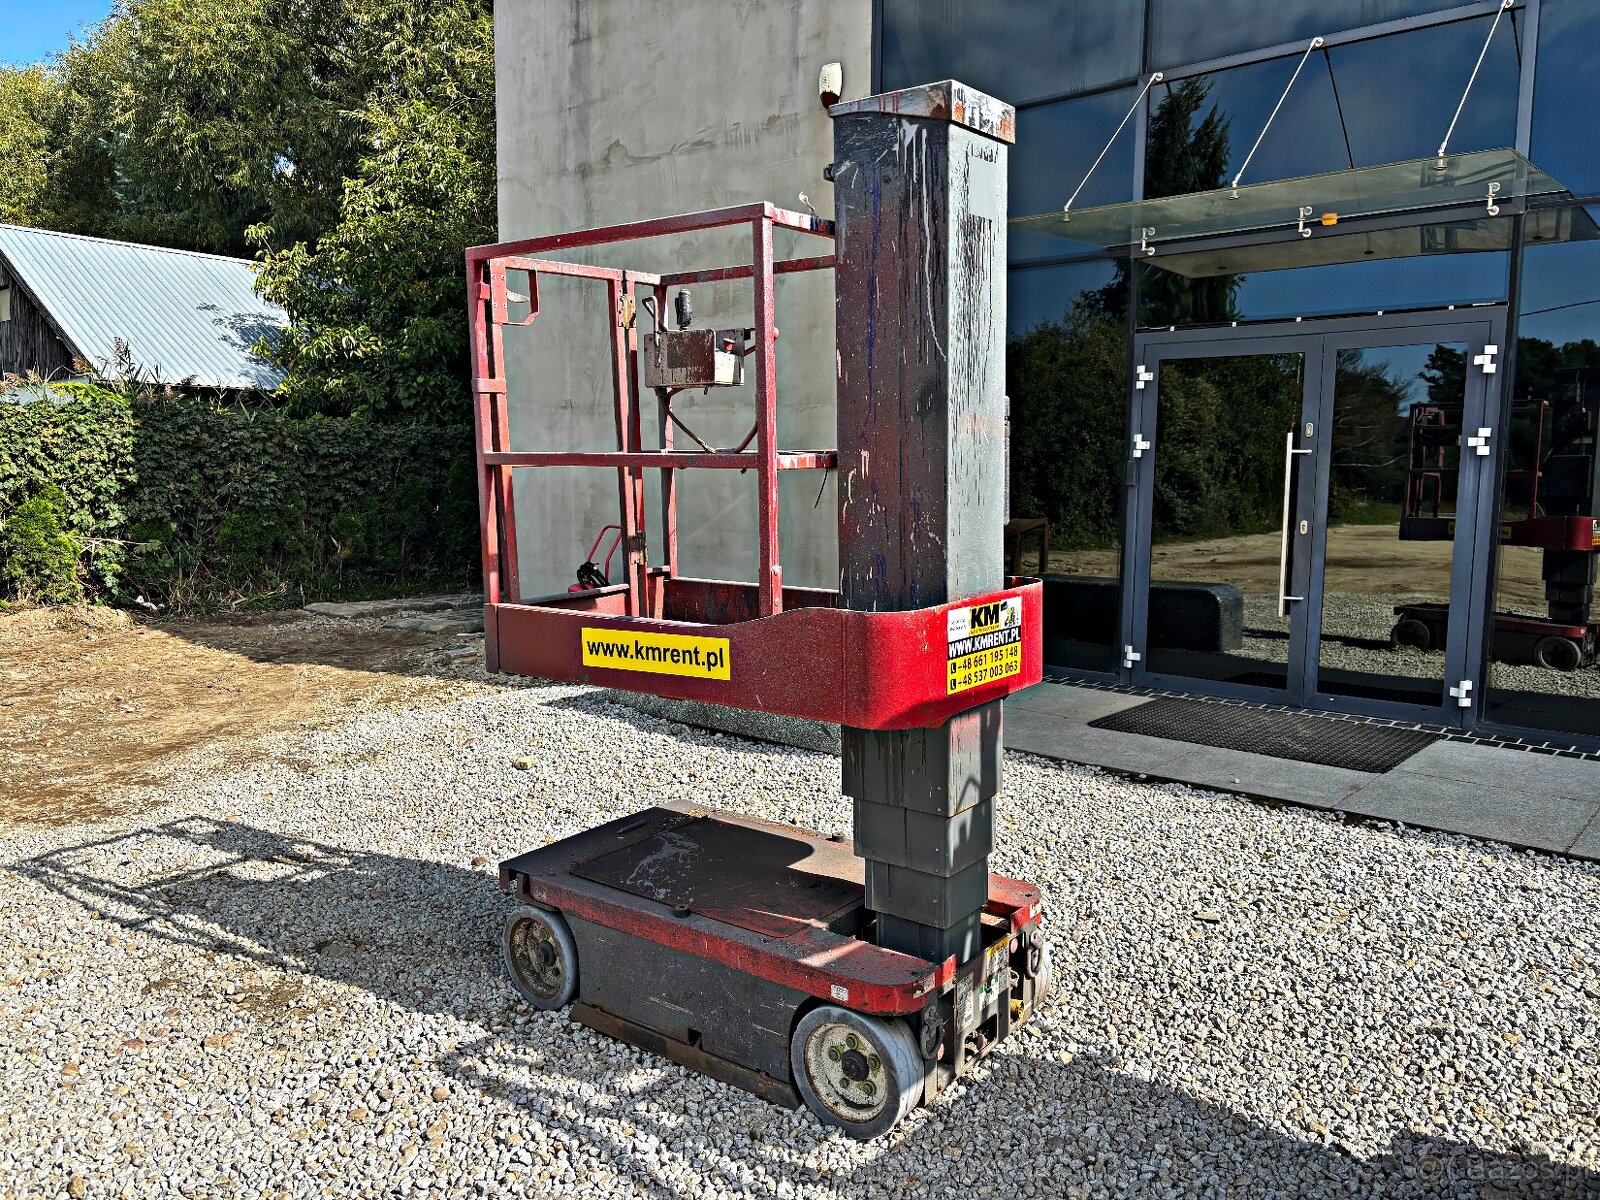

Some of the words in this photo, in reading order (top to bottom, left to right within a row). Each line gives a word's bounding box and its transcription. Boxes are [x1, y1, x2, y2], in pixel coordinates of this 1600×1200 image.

[971, 604, 1000, 629] KM
[587, 640, 724, 671] www.kmrent.pl
[948, 627, 1020, 659] WWW.KMRENT.PL
[974, 653, 987, 668] 661
[990, 649, 1003, 663] 195
[1005, 646, 1018, 657] 148
[974, 669, 987, 683] 537
[989, 664, 1003, 678] 003
[1005, 660, 1018, 673] 063
